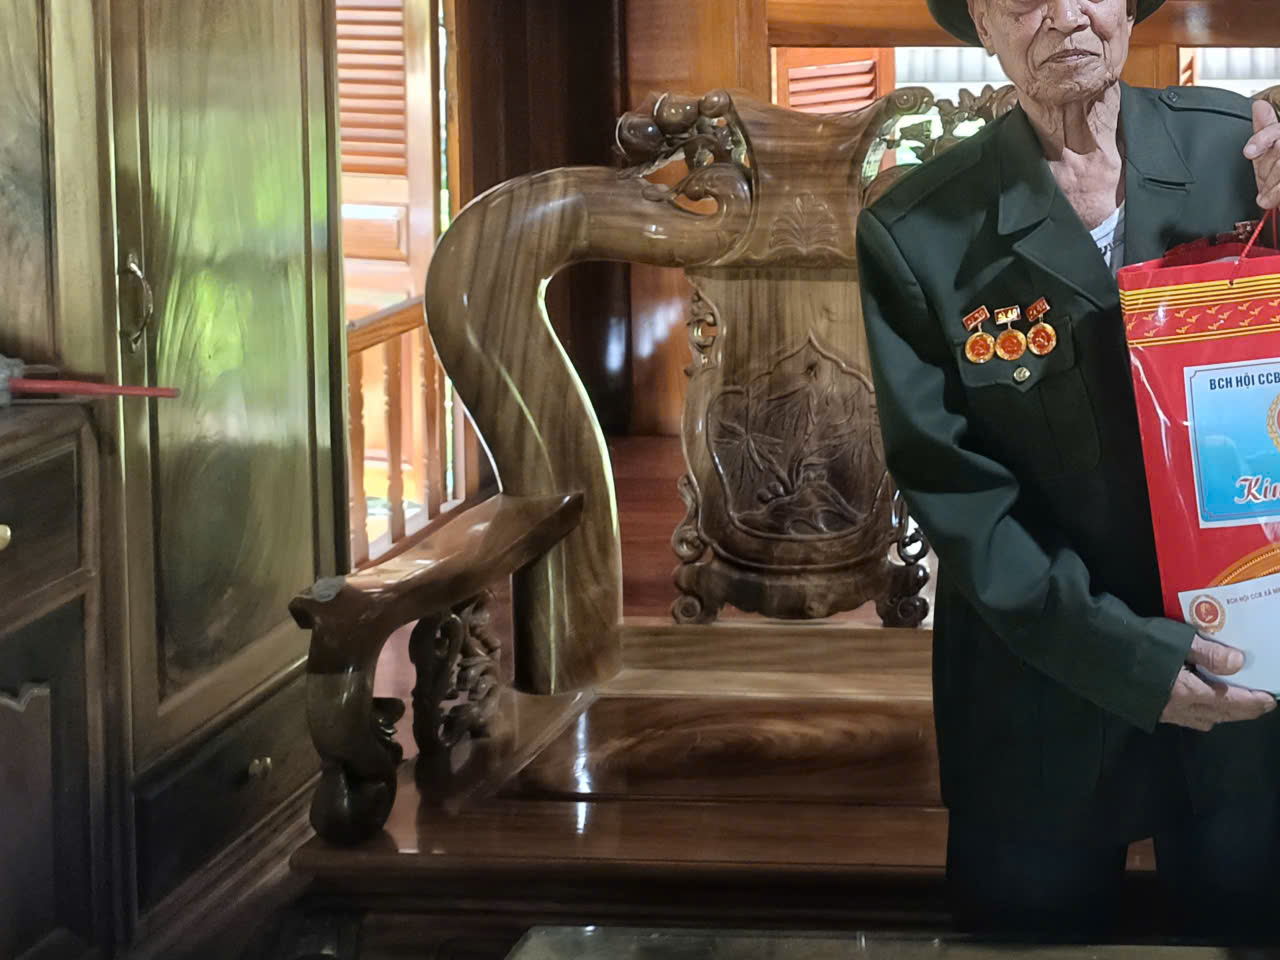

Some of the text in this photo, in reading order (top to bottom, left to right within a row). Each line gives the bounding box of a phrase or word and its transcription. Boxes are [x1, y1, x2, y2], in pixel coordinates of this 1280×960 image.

[1209, 376, 1233, 390] BCH
[1235, 372, 1255, 389] HỘI
[1258, 372, 1280, 385] CCB
